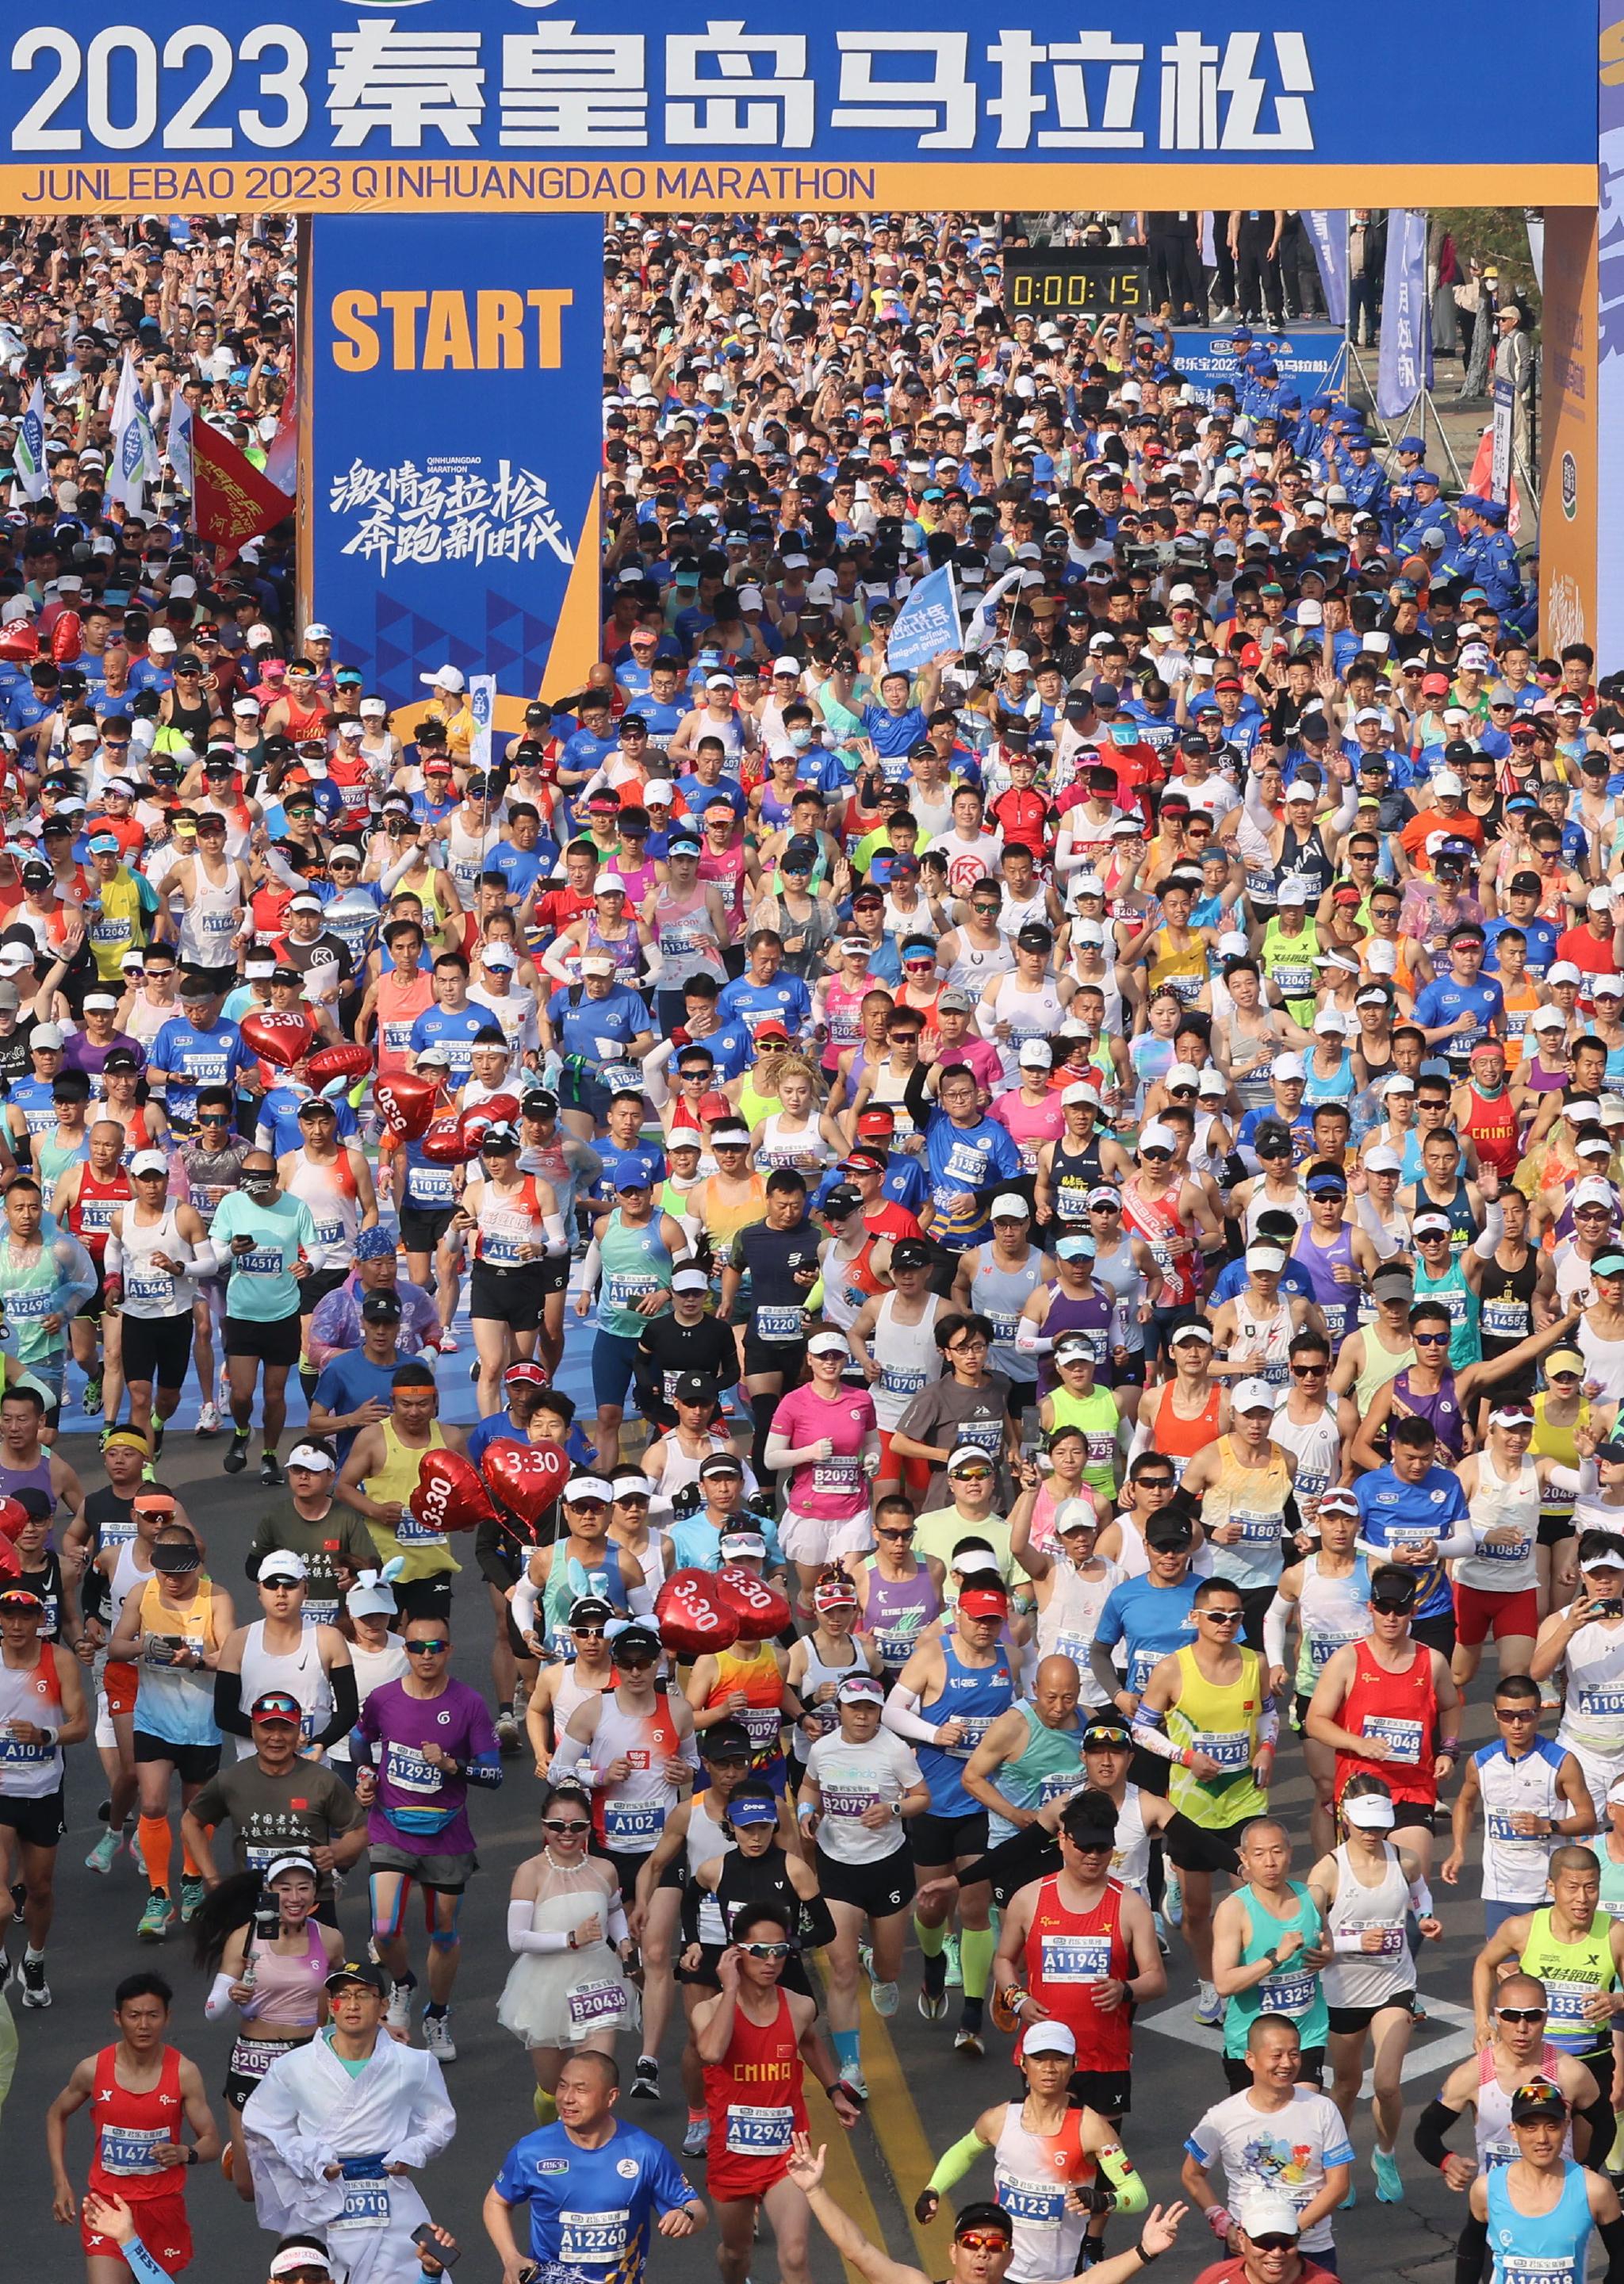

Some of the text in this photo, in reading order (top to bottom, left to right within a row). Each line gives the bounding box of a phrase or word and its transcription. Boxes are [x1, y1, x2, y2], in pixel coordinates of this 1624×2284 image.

[21, 167, 875, 201] JUNLEBAO 2023 QINHUANGDAO MARATHON
[1013, 274, 1139, 307] 0:00:15
[331, 289, 573, 371] START
[329, 458, 550, 520] 激情马拉松
[341, 508, 575, 578] 奔跑新时代
[885, 766, 904, 776] 344
[93, 926, 130, 937] A12067
[663, 942, 691, 952] A136
[1274, 975, 1310, 985] A12045
[260, 1014, 305, 1029] 5:30
[186, 1065, 227, 1075] A11696
[378, 1087, 407, 1132] 5:30
[1472, 1126, 1514, 1140] CHINA
[948, 1155, 987, 1175] A13539
[410, 1180, 452, 1191] A10183
[318, 1229, 338, 1242] 117
[238, 1255, 281, 1270] A14516
[129, 1281, 173, 1295] A13645
[1484, 1313, 1527, 1326] A14582
[881, 1374, 925, 1389] A10708
[1092, 1443, 1113, 1456] 735
[508, 1450, 559, 1473] 3:30
[422, 1477, 452, 1527] 3:30
[301, 1551, 332, 1565] 国老兵
[722, 1569, 772, 1608] 3:30
[674, 1580, 718, 1631] 3:30
[876, 1641, 914, 1657] A143
[388, 1758, 442, 1781] A12935
[250, 1811, 300, 1826] 中国老兵
[615, 1815, 654, 1830] A102
[1044, 1953, 1108, 1968] A11945
[1262, 1981, 1316, 2006] A13254
[573, 1992, 626, 2016] B20436
[734, 2062, 791, 2082] CHINA
[729, 2123, 791, 2140] A12947
[1005, 2192, 1049, 2215] A123
[561, 2228, 626, 2247] A12260
[134, 2244, 159, 2274] BEST
